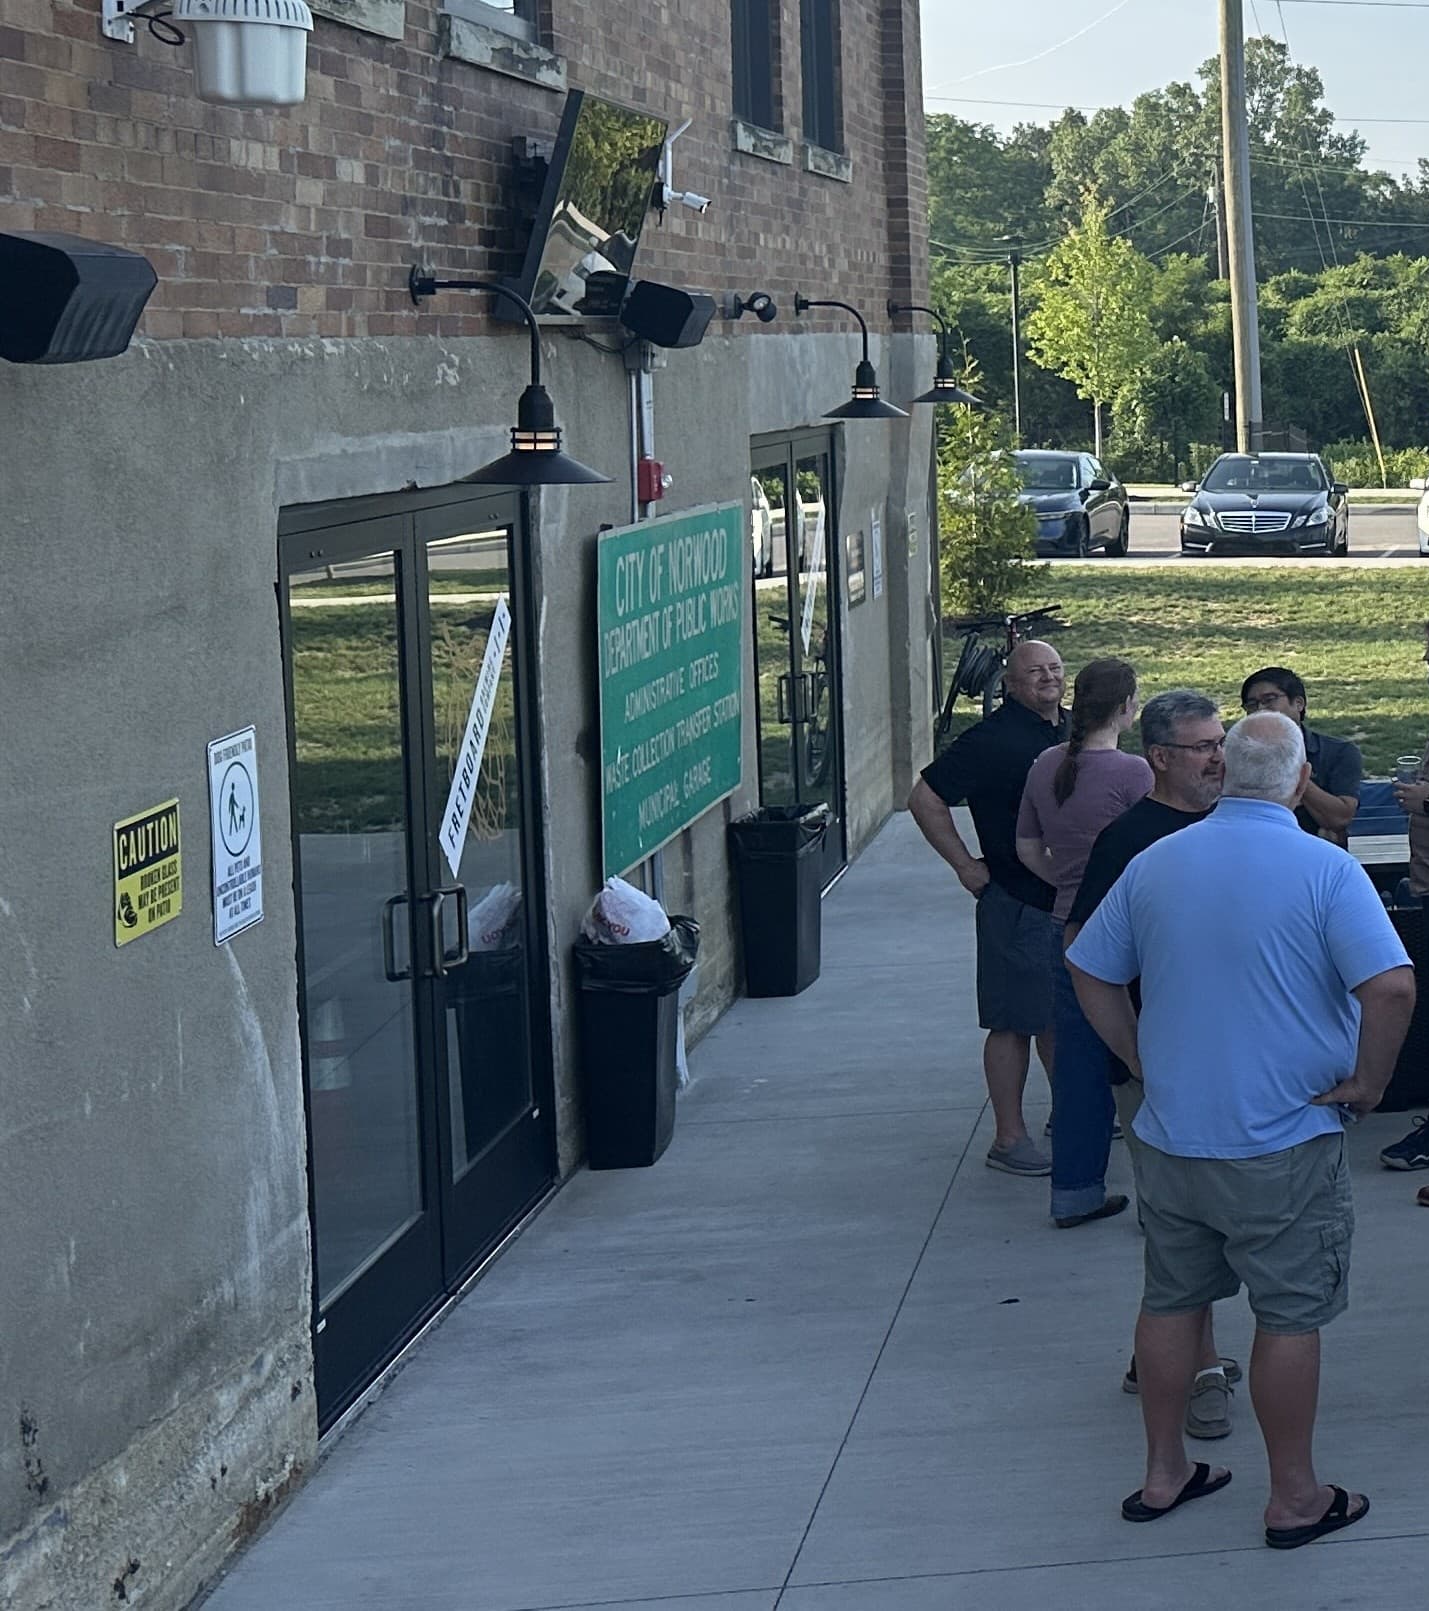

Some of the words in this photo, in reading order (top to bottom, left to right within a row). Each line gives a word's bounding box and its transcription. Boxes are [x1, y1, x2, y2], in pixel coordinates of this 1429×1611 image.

[616, 549, 645, 616] CITY
[650, 544, 665, 604] OF
[669, 528, 727, 594] NORWOOD
[604, 611, 660, 678] DEPARTMENT
[662, 605, 673, 649] OF
[676, 593, 707, 643] PUBLIC
[710, 582, 739, 628] WORKS
[625, 667, 685, 723] ADMINISTRATIVE
[689, 651, 719, 689] OFFICES
[448, 709, 484, 849] FRETBOARD
[605, 752, 630, 794] WASTE
[632, 727, 675, 777] COLLECTION
[676, 705, 712, 749] TRANSFER
[714, 692, 740, 728] STATION
[638, 780, 680, 830] MUNICIPAL
[683, 756, 712, 799] GARAGE
[120, 812, 177, 870] CAUTION
